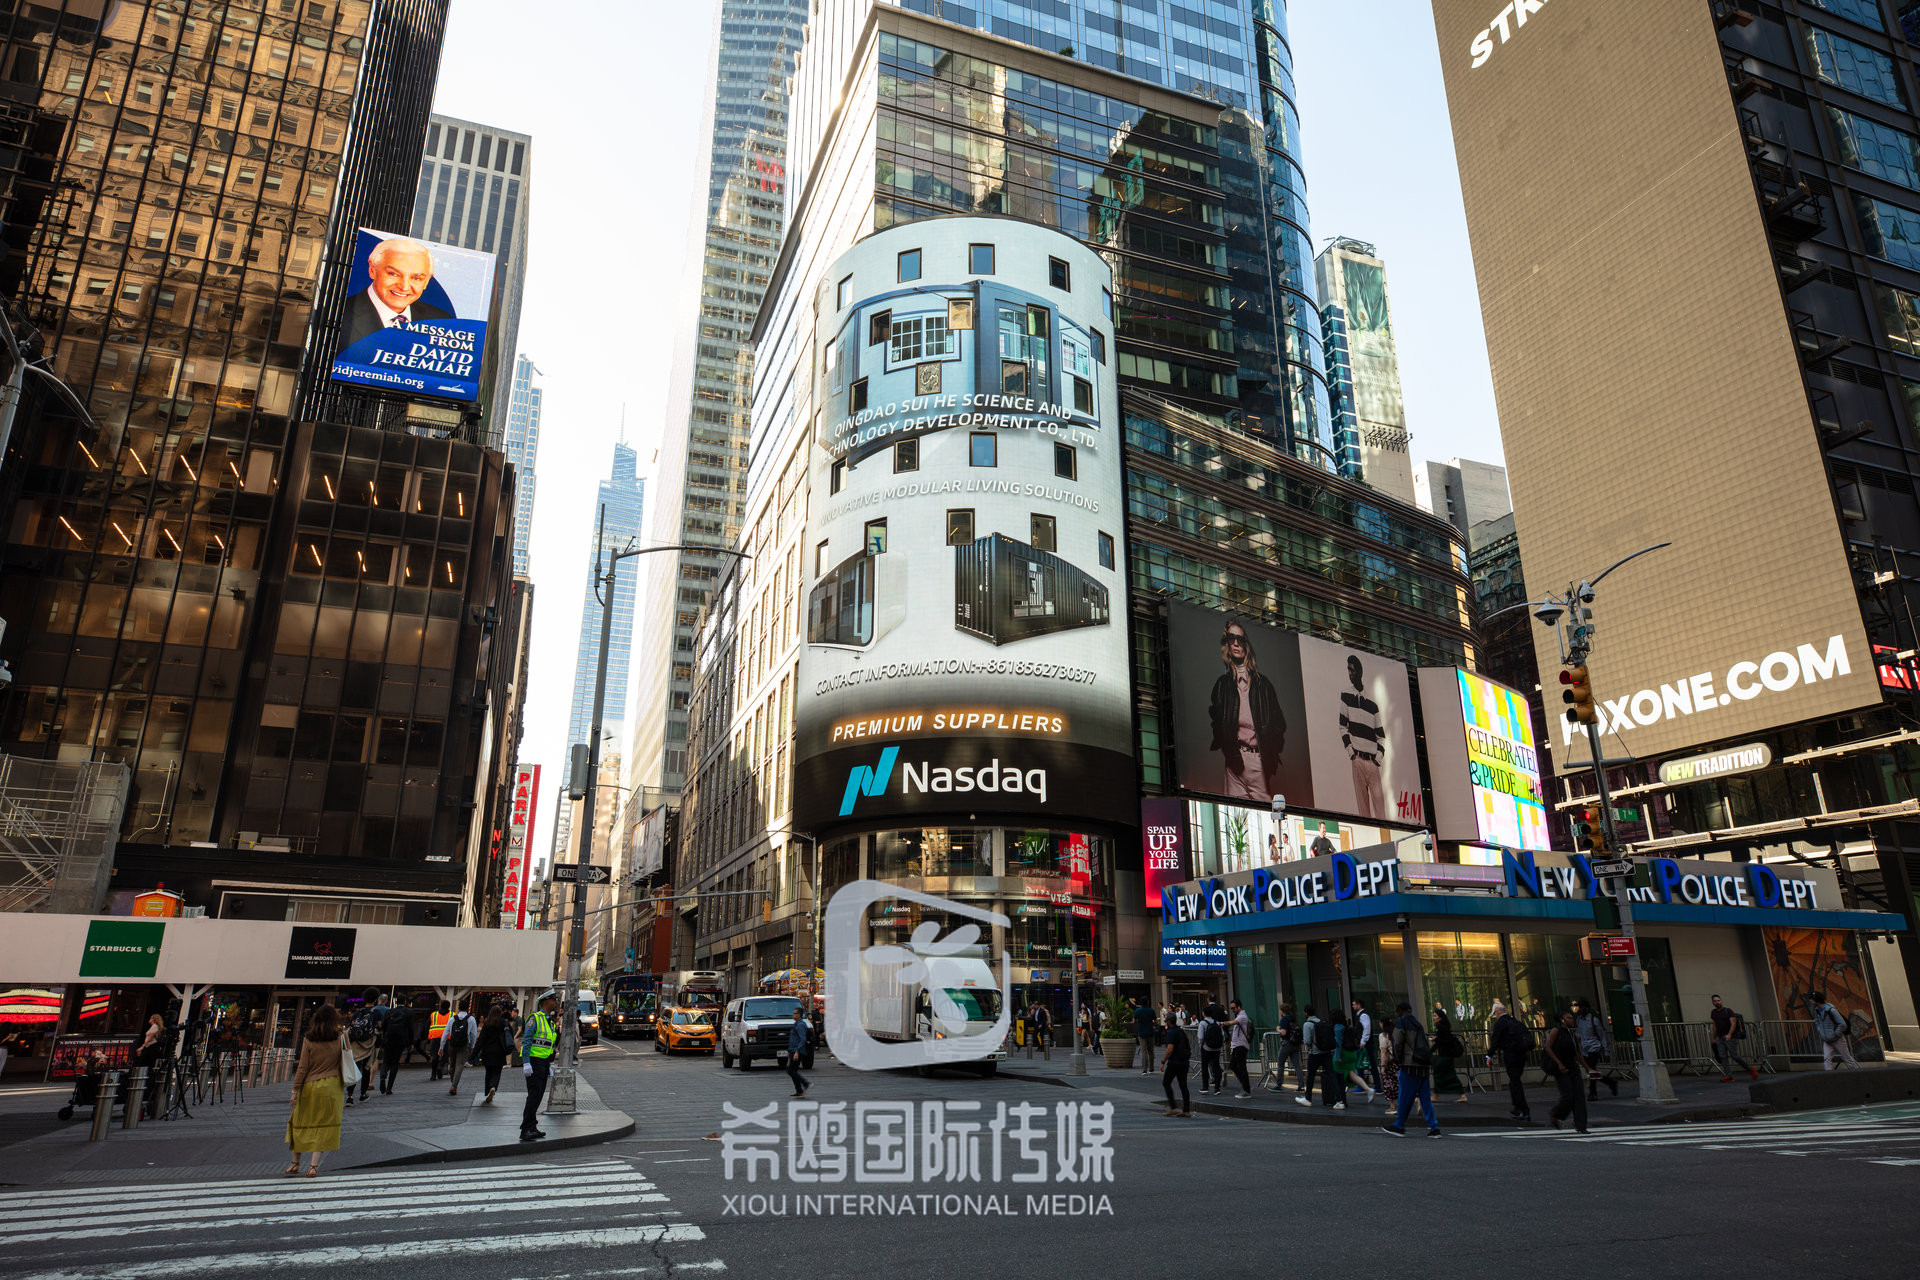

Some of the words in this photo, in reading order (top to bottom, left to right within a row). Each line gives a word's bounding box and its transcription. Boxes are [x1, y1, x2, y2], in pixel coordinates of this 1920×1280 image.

[1470, 0, 1549, 69] STR
[391, 320, 402, 329] A
[405, 322, 475, 342] MESSAGE
[429, 335, 474, 351] FROM
[369, 349, 473, 377] JEREMIAH
[409, 343, 474, 364] DAVID
[834, 402, 897, 437] QINGDAO
[900, 396, 928, 414] SUI
[934, 394, 957, 408] HE
[961, 393, 1035, 411] SCIENCE
[1038, 401, 1072, 420] AND
[902, 412, 1034, 432] DEVELOPMENT
[1037, 420, 1068, 440] CO.,
[1071, 429, 1099, 450] LTD.
[883, 480, 962, 500] MODULAR
[966, 479, 1021, 494] LIVING
[1024, 483, 1100, 513] SOLUTIONS
[815, 669, 864, 696] CONTACT
[833, 715, 923, 743] PREMIUM
[932, 713, 1064, 733] SUPPLIERS
[902, 758, 1047, 804] Nasdaq
[1482, 763, 1519, 797] PRIDE
[514, 772, 531, 825] PARK
[1397, 791, 1422, 822] H&M
[1147, 826, 1177, 835] SPAIN
[1149, 834, 1178, 851] UP
[1149, 850, 1178, 859] YOUR
[1149, 858, 1179, 870] LIFE
[1595, 865, 1609, 874] ONE
[1615, 863, 1628, 872] WAY
[503, 857, 521, 913] PARK
[1161, 885, 1200, 924] NEW
[1199, 878, 1252, 919] YORK
[1253, 868, 1326, 911] POLICE
[1331, 853, 1398, 900] DEPT
[1502, 848, 1576, 898] NEW
[1656, 857, 1749, 906] POLICE
[1749, 864, 1819, 909] DEPT
[1026, 905, 1047, 914] Nasdaq
[90, 945, 142, 953] STARBUCKS
